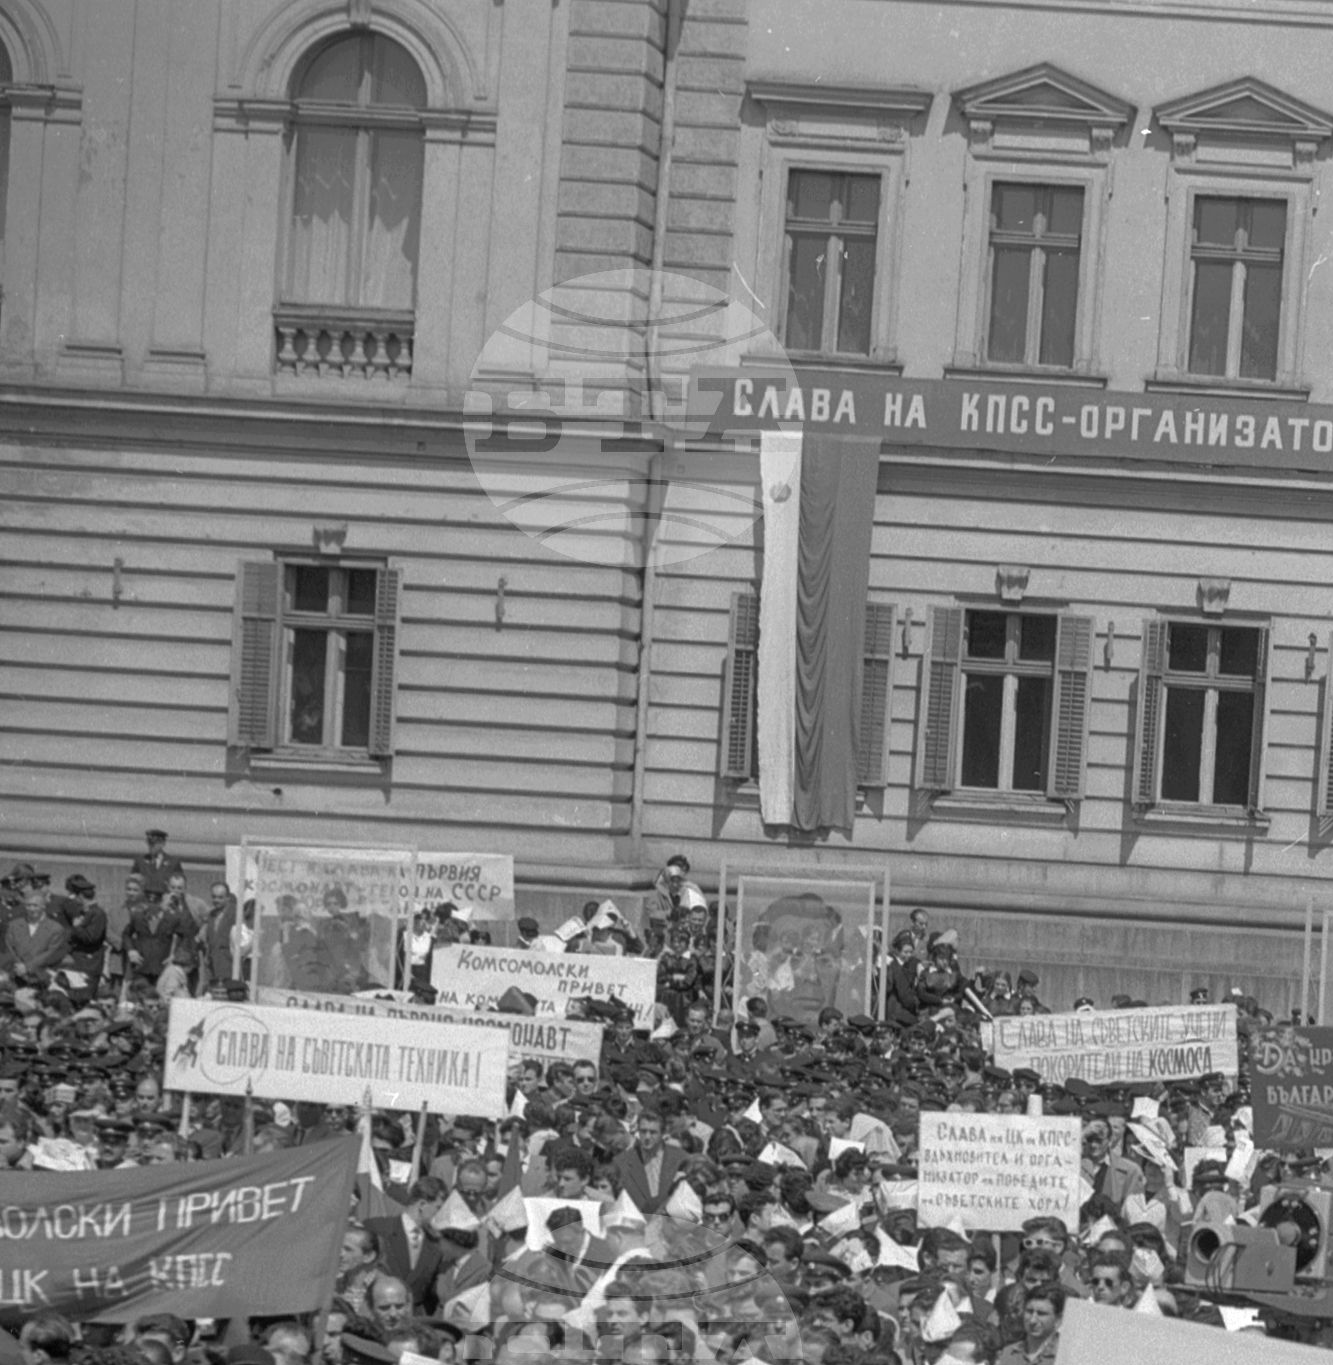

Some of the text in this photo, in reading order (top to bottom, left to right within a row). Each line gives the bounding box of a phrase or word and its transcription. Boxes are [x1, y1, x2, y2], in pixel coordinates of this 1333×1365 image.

[733, 378, 856, 425] СЛАВА
[884, 393, 927, 429] НА
[416, 863, 481, 882] ПЪРВИЯ
[426, 888, 443, 899] НА
[452, 883, 501, 901] СССР
[439, 991, 459, 1005] НА
[557, 980, 628, 997] ПРИВЕТ
[1000, 1019, 1057, 1049] СЛАВА
[1066, 1019, 1084, 1047] НА
[1091, 1014, 1171, 1046] СЪВЕТСКИТЕ
[216, 1030, 482, 1088] СЛАВА НА СЪВЕТСКАТА ТЕХНИКА!
[1126, 1048, 1145, 1079] НА
[1150, 1046, 1212, 1077] КОСМОСА
[937, 1122, 987, 1143] СЛАВА
[1006, 1129, 1023, 1148] ЦК
[924, 1149, 1008, 1166] ВДЪХНОВИТЕЛ
[1014, 1154, 1024, 1165] И
[923, 1170, 979, 1184] НИЗАТОР
[996, 1173, 1068, 1191] ПОБЕДИТЕ
[157, 1176, 316, 1231] ПРИВЕТ
[936, 1192, 1020, 1210] СЪВЕТСКИТЕ
[73, 1266, 128, 1299] НА
[150, 1253, 232, 1290] КПСС
